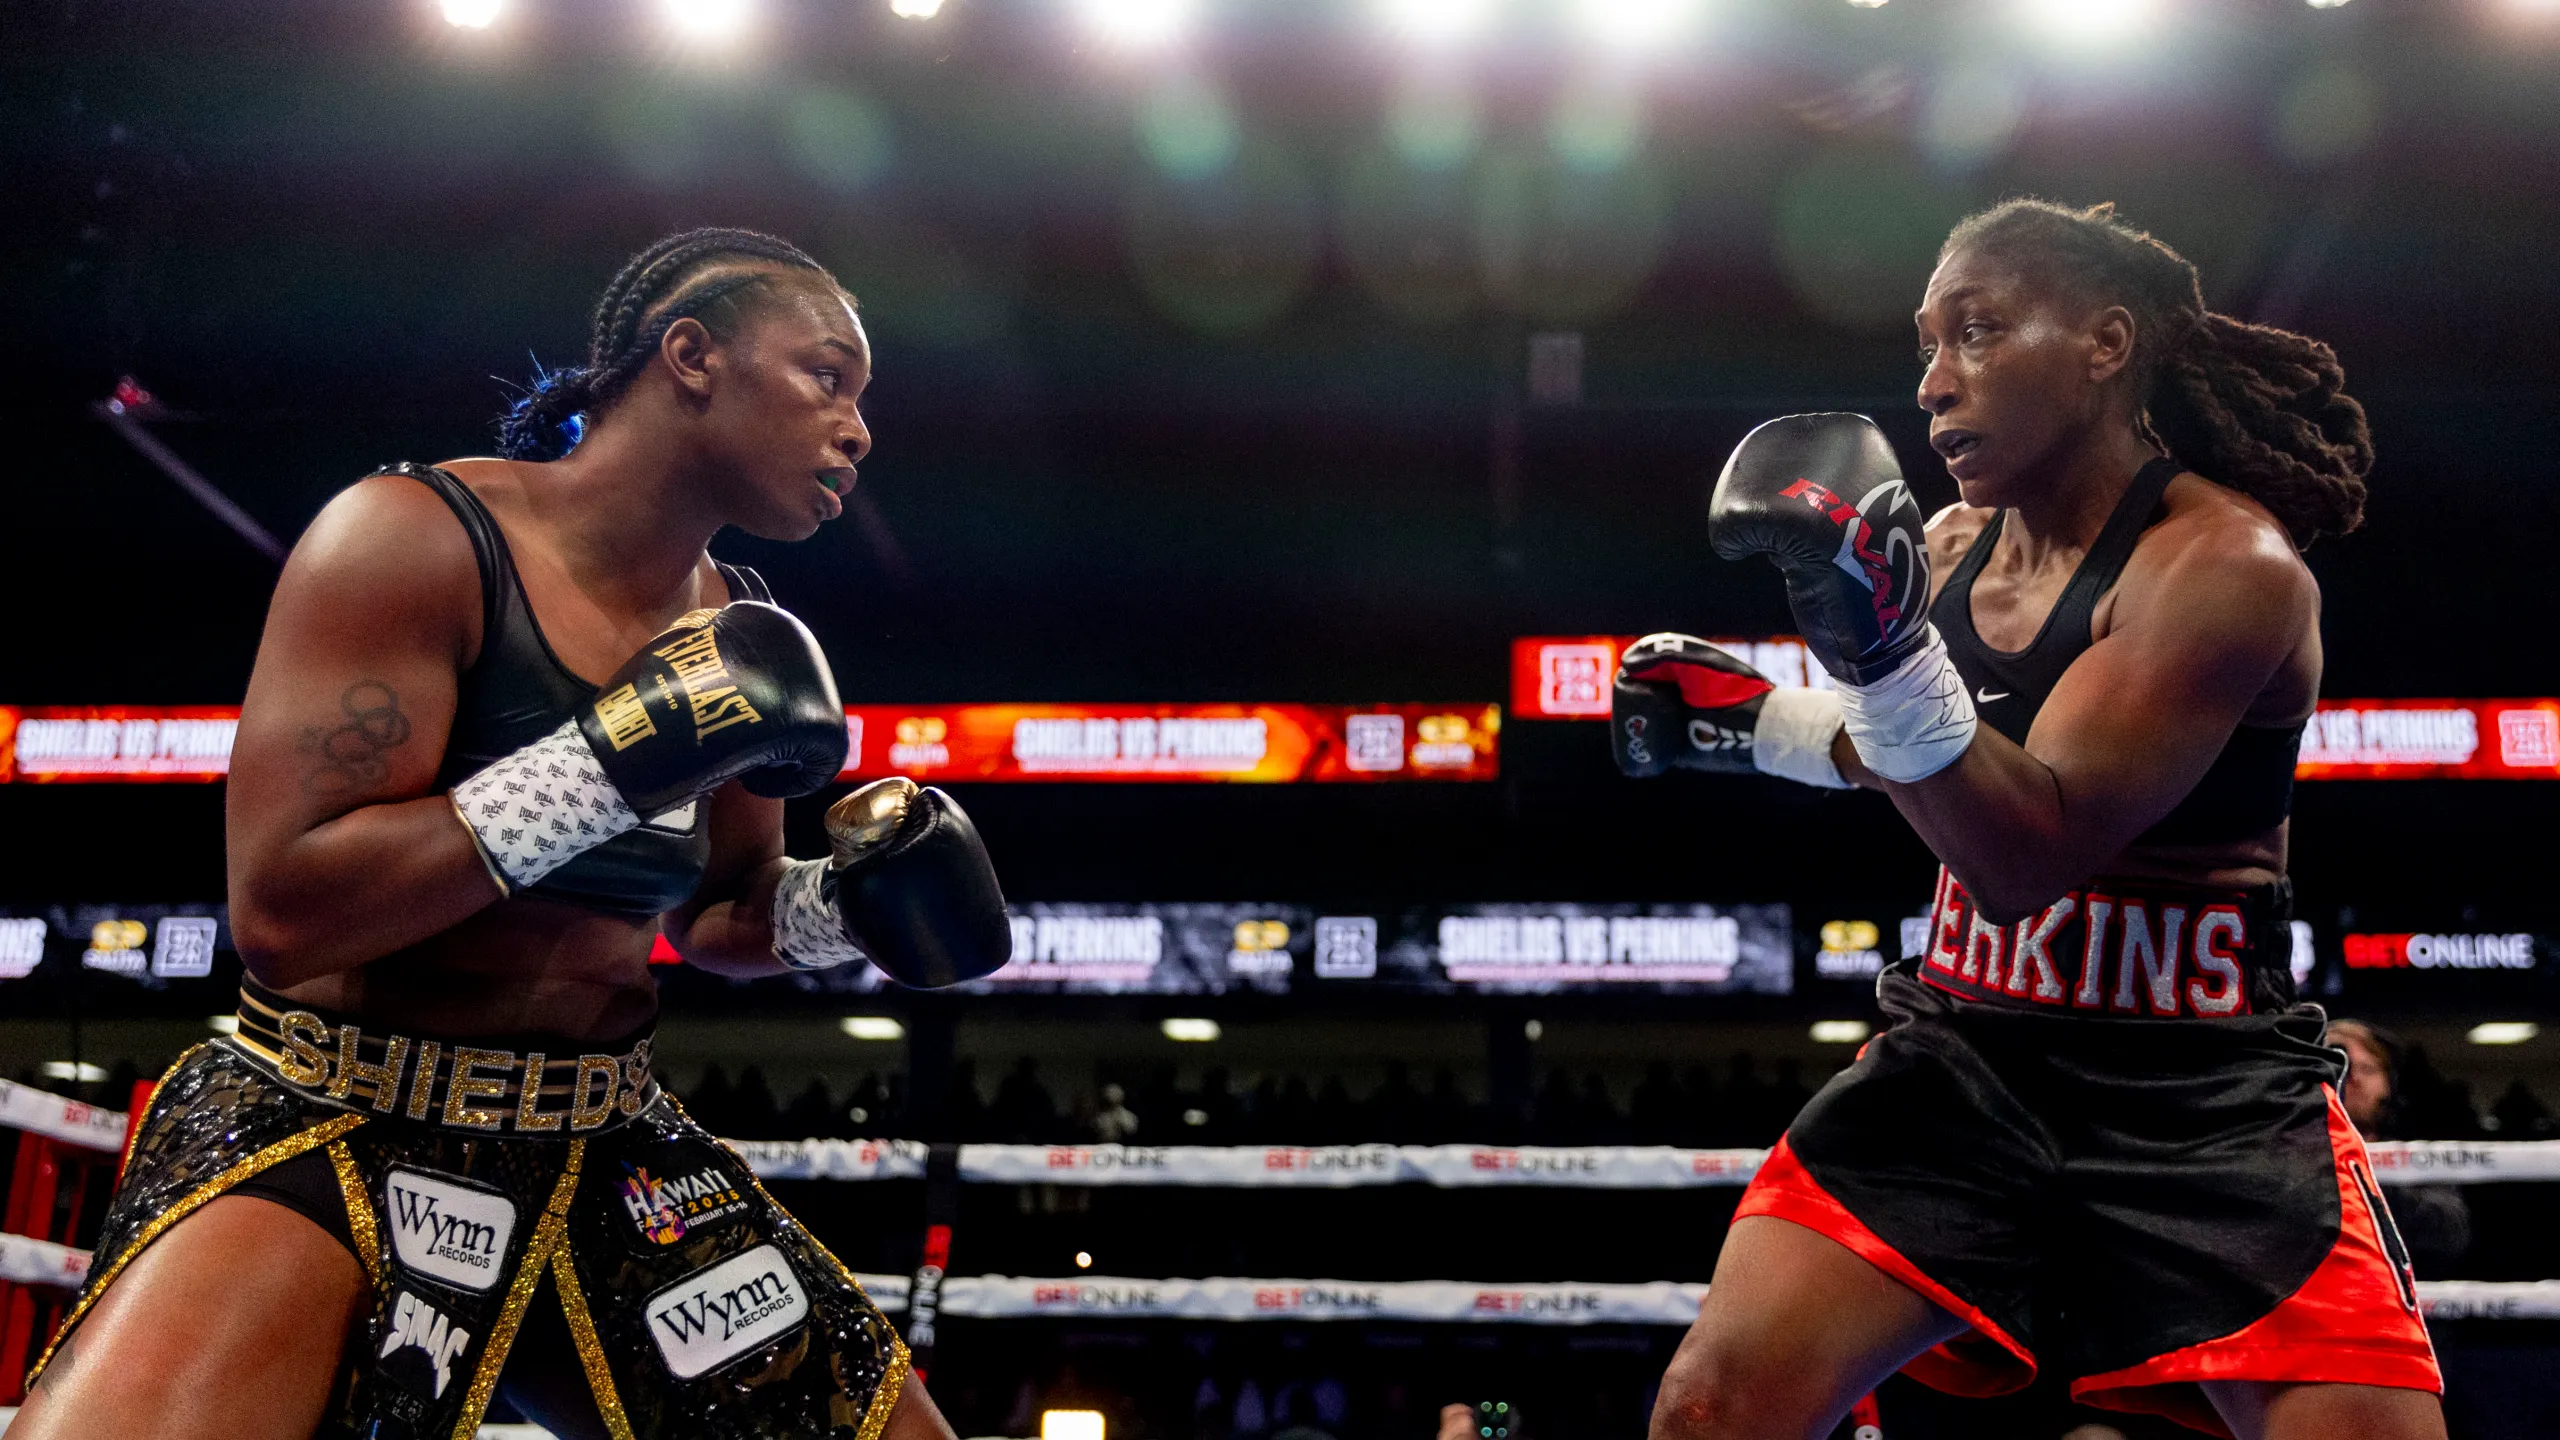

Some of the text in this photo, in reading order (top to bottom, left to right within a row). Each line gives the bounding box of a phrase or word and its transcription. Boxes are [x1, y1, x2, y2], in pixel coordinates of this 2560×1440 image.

[1779, 477, 1902, 643] RIVAL
[653, 626, 763, 745] EVERLAST
[16, 718, 120, 760] SHIELDS
[121, 718, 158, 760] VS
[1013, 718, 1267, 760] SHIELDS VS PERKINS
[2361, 709, 2478, 752] PERKINS
[504, 781, 526, 794] EVERLAST
[519, 806, 542, 822] EVERLAST
[1036, 916, 1163, 966] PERKINS
[1439, 916, 1740, 967] SHIELDS VS PERKINS
[1931, 863, 2246, 1016] ERKINS
[2343, 933, 2536, 969] BETONLINE
[278, 1010, 651, 1131] SHIELDS
[393, 1186, 496, 1255] Wynn
[684, 1202, 748, 1229] FEBRUARY 15-16
[687, 1189, 740, 1214] 2025
[439, 1245, 491, 1270] RECORDS
[655, 1271, 789, 1345] Wynn
[734, 1293, 794, 1330] RECORDS
[380, 1291, 470, 1400] SNAC
